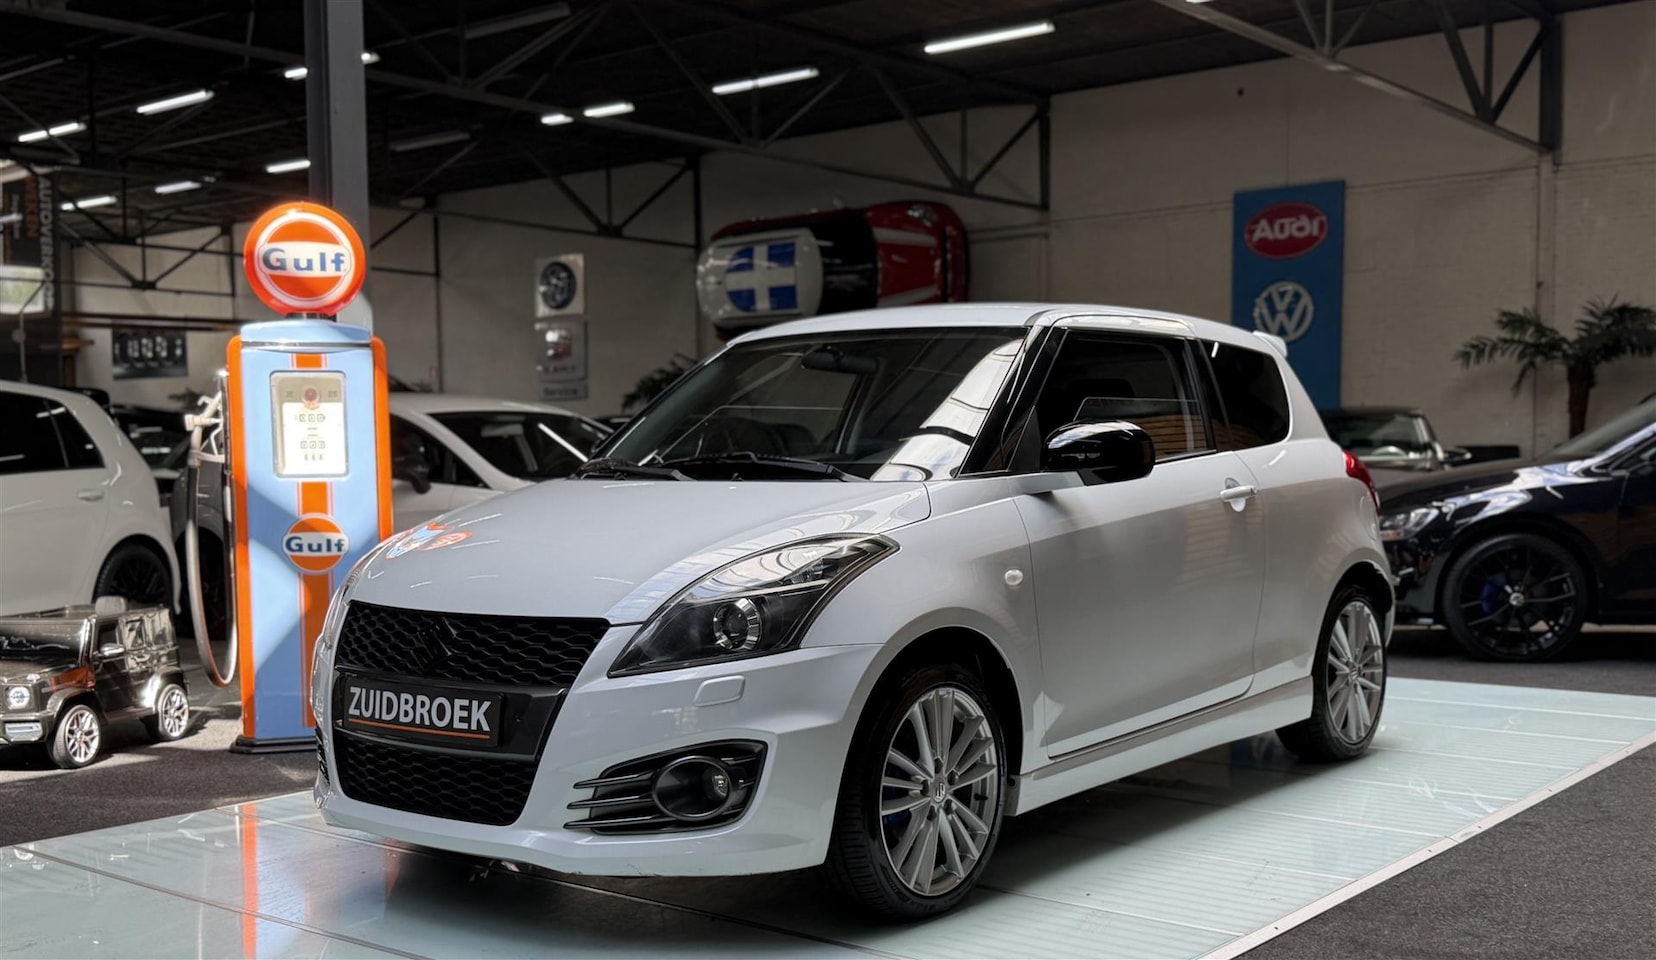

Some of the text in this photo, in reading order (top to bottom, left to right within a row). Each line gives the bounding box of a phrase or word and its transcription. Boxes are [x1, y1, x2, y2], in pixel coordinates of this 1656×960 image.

[262, 247, 345, 273] Gulf
[285, 536, 345, 553] Gulf
[348, 686, 492, 732] ZUIDBROEK
